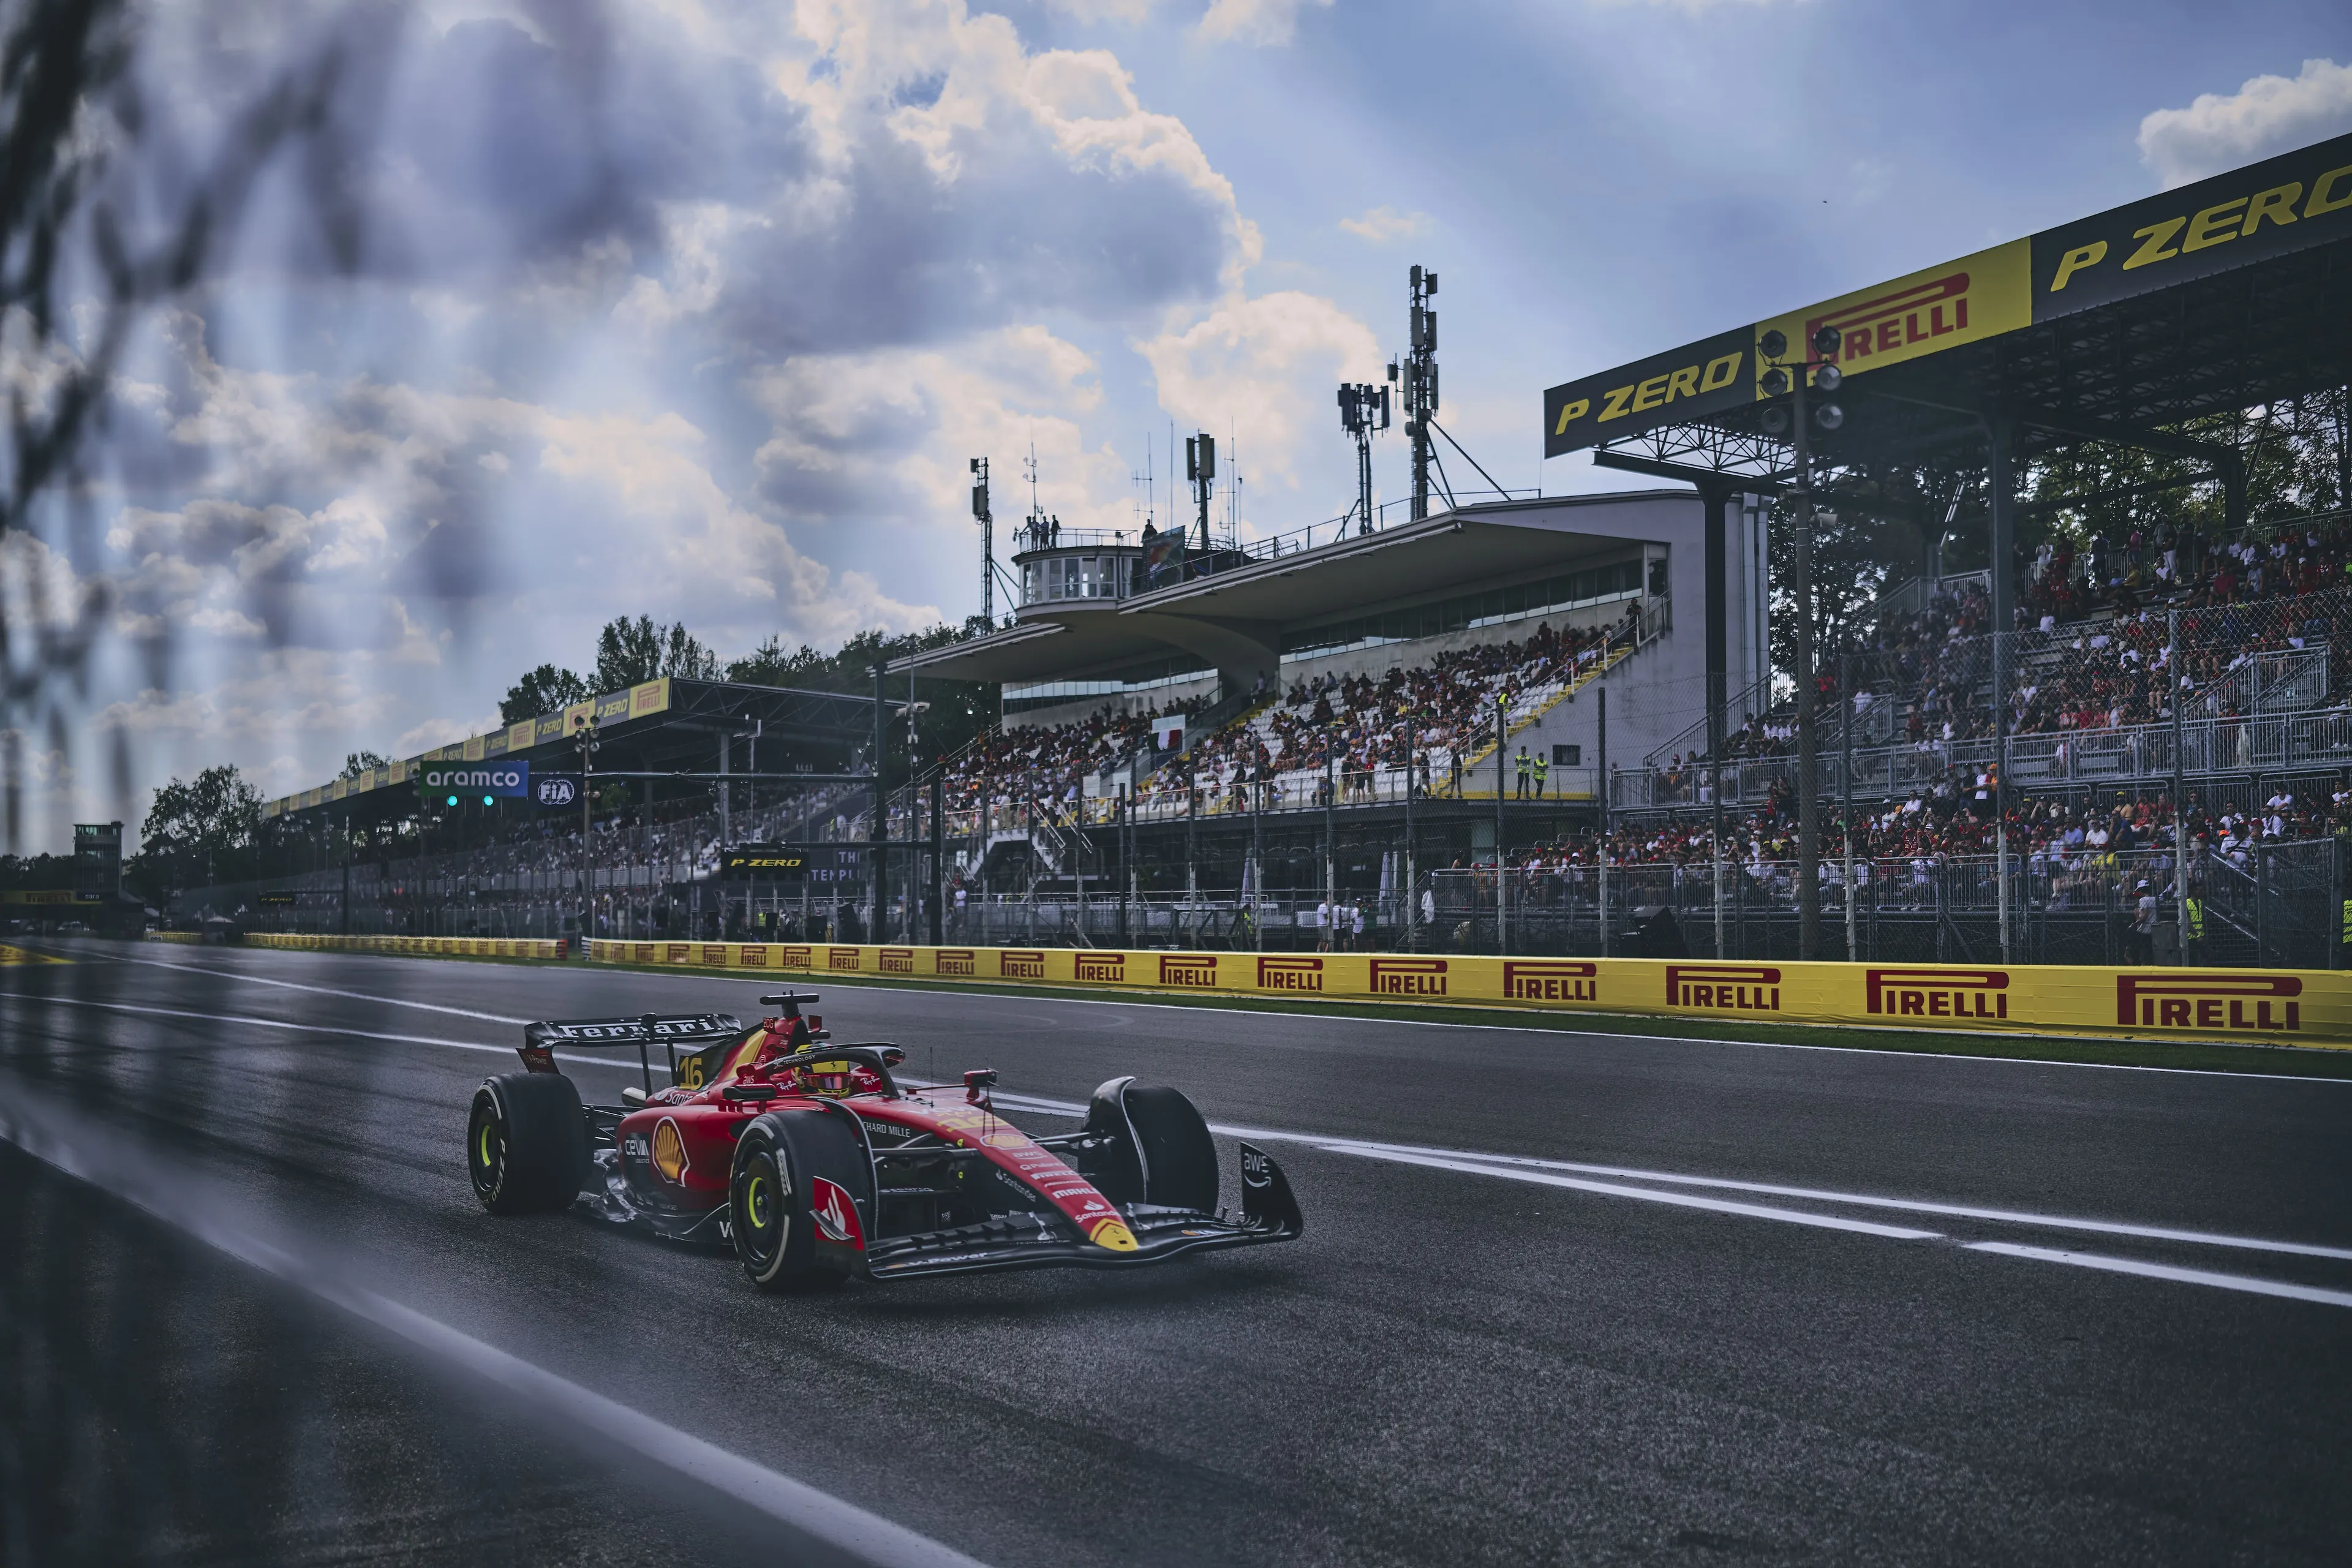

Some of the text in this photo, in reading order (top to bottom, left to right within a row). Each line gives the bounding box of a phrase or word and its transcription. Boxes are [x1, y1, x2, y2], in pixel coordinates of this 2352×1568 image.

[2050, 164, 2352, 292] P ZERO
[1555, 352, 1743, 435] P ZERO
[597, 698, 628, 717] P ZERO
[637, 684, 660, 712] PIRELLI
[537, 726, 541, 737] P
[542, 718, 562, 734] ZERO
[426, 772, 519, 787] aramco
[839, 852, 860, 863] TH
[703, 946, 726, 965] PIRELLI
[741, 946, 767, 966] PIRELLI
[783, 947, 811, 968] PIRELLI
[829, 948, 859, 970] PIRELLI
[880, 949, 913, 973] PIRELLI
[936, 950, 974, 975] PIRELLI
[1000, 951, 1044, 978] PIRELLI
[1075, 954, 1124, 981] PIRELLI
[1159, 956, 1218, 987] PIRELLI
[1257, 957, 1324, 991] PIRELLI
[1370, 960, 1448, 995] PIRELLI
[1503, 962, 1597, 1001] PIRELLI
[1666, 966, 1781, 1011] PIRELLI
[1866, 969, 2010, 1019] PIRELLI
[2117, 975, 2303, 1030] PIRELLI
[558, 1019, 715, 1038] Ferrari
[678, 1057, 703, 1090] 16
[936, 1115, 1011, 1133] 16
[1003, 1173, 1036, 1202] Santander
